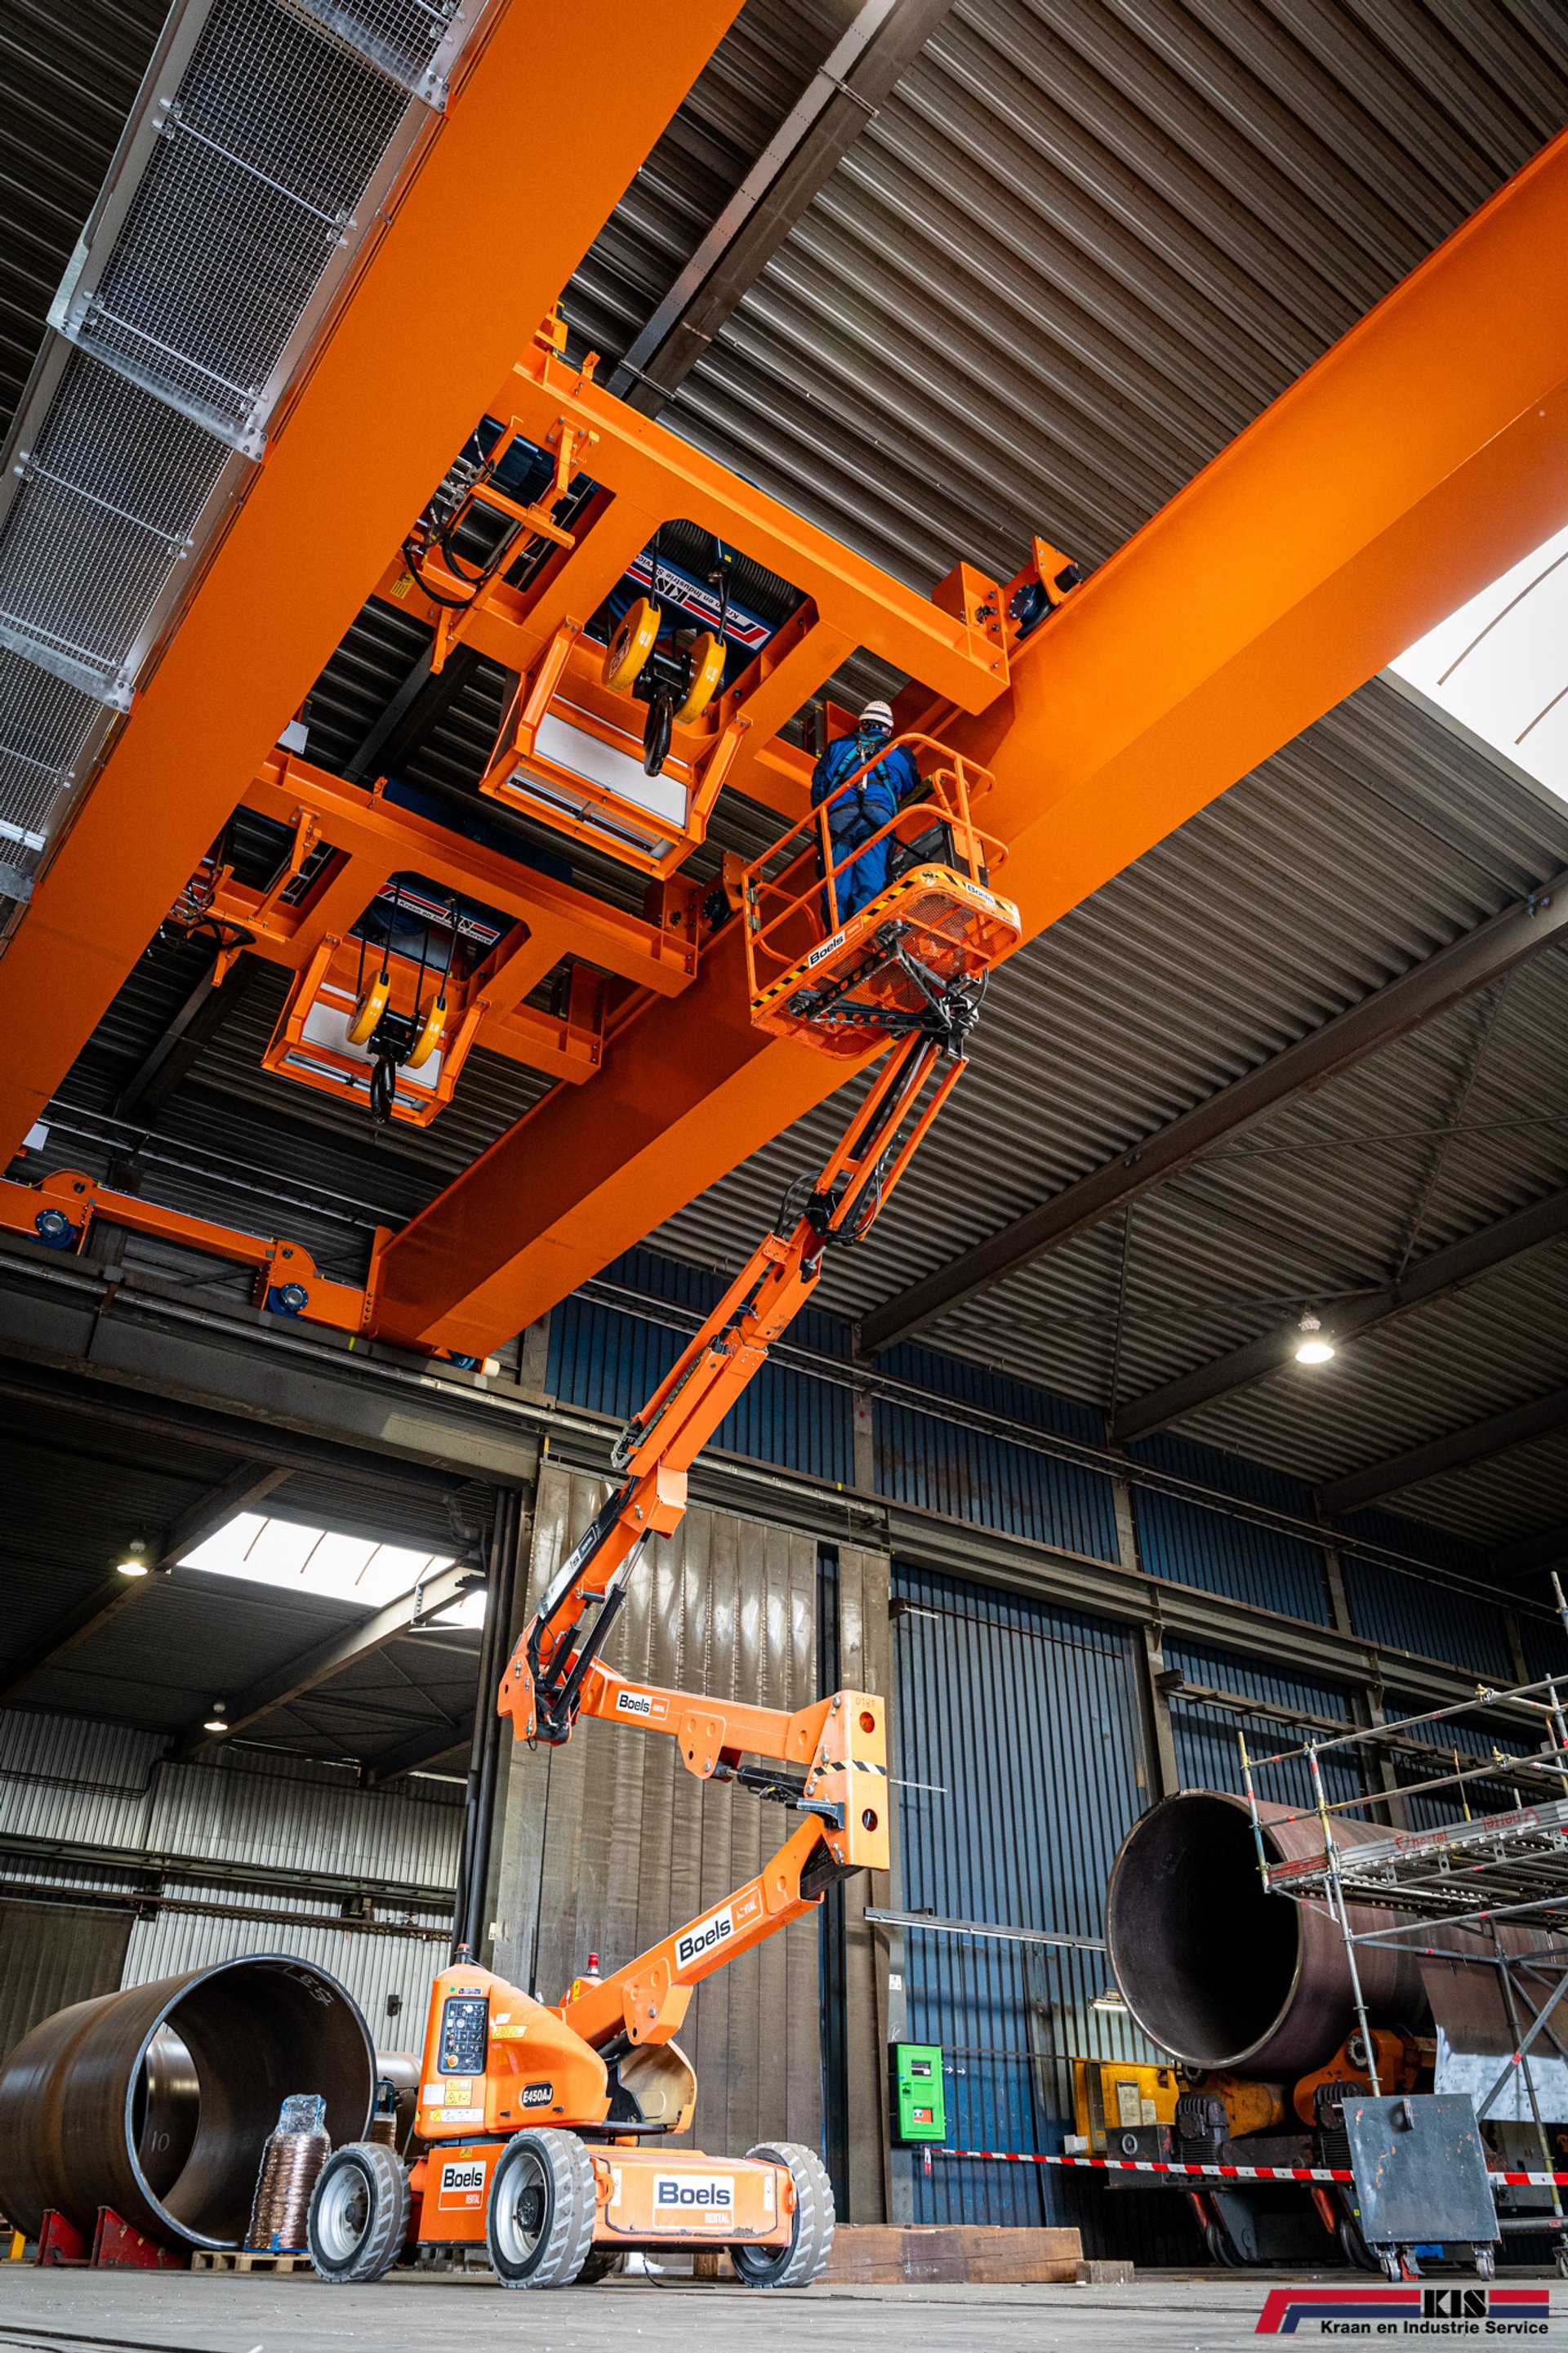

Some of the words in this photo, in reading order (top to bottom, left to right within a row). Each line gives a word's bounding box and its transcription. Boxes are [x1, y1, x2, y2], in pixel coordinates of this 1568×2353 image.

[654, 577, 688, 604] KIS
[666, 573, 702, 598] Industrie
[702, 595, 714, 604] en
[967, 884, 994, 904] Boels
[400, 901, 421, 913] Kraan
[466, 929, 491, 943] Service
[809, 936, 844, 965] Boels
[619, 1694, 650, 1713] Boels
[679, 1919, 731, 1962] Boels
[523, 2088, 553, 2103] E450AJ
[151, 2131, 170, 2152] 10
[443, 2167, 483, 2188] Boels
[658, 2181, 731, 2205] Boels
[705, 2213, 729, 2224] RENTAL
